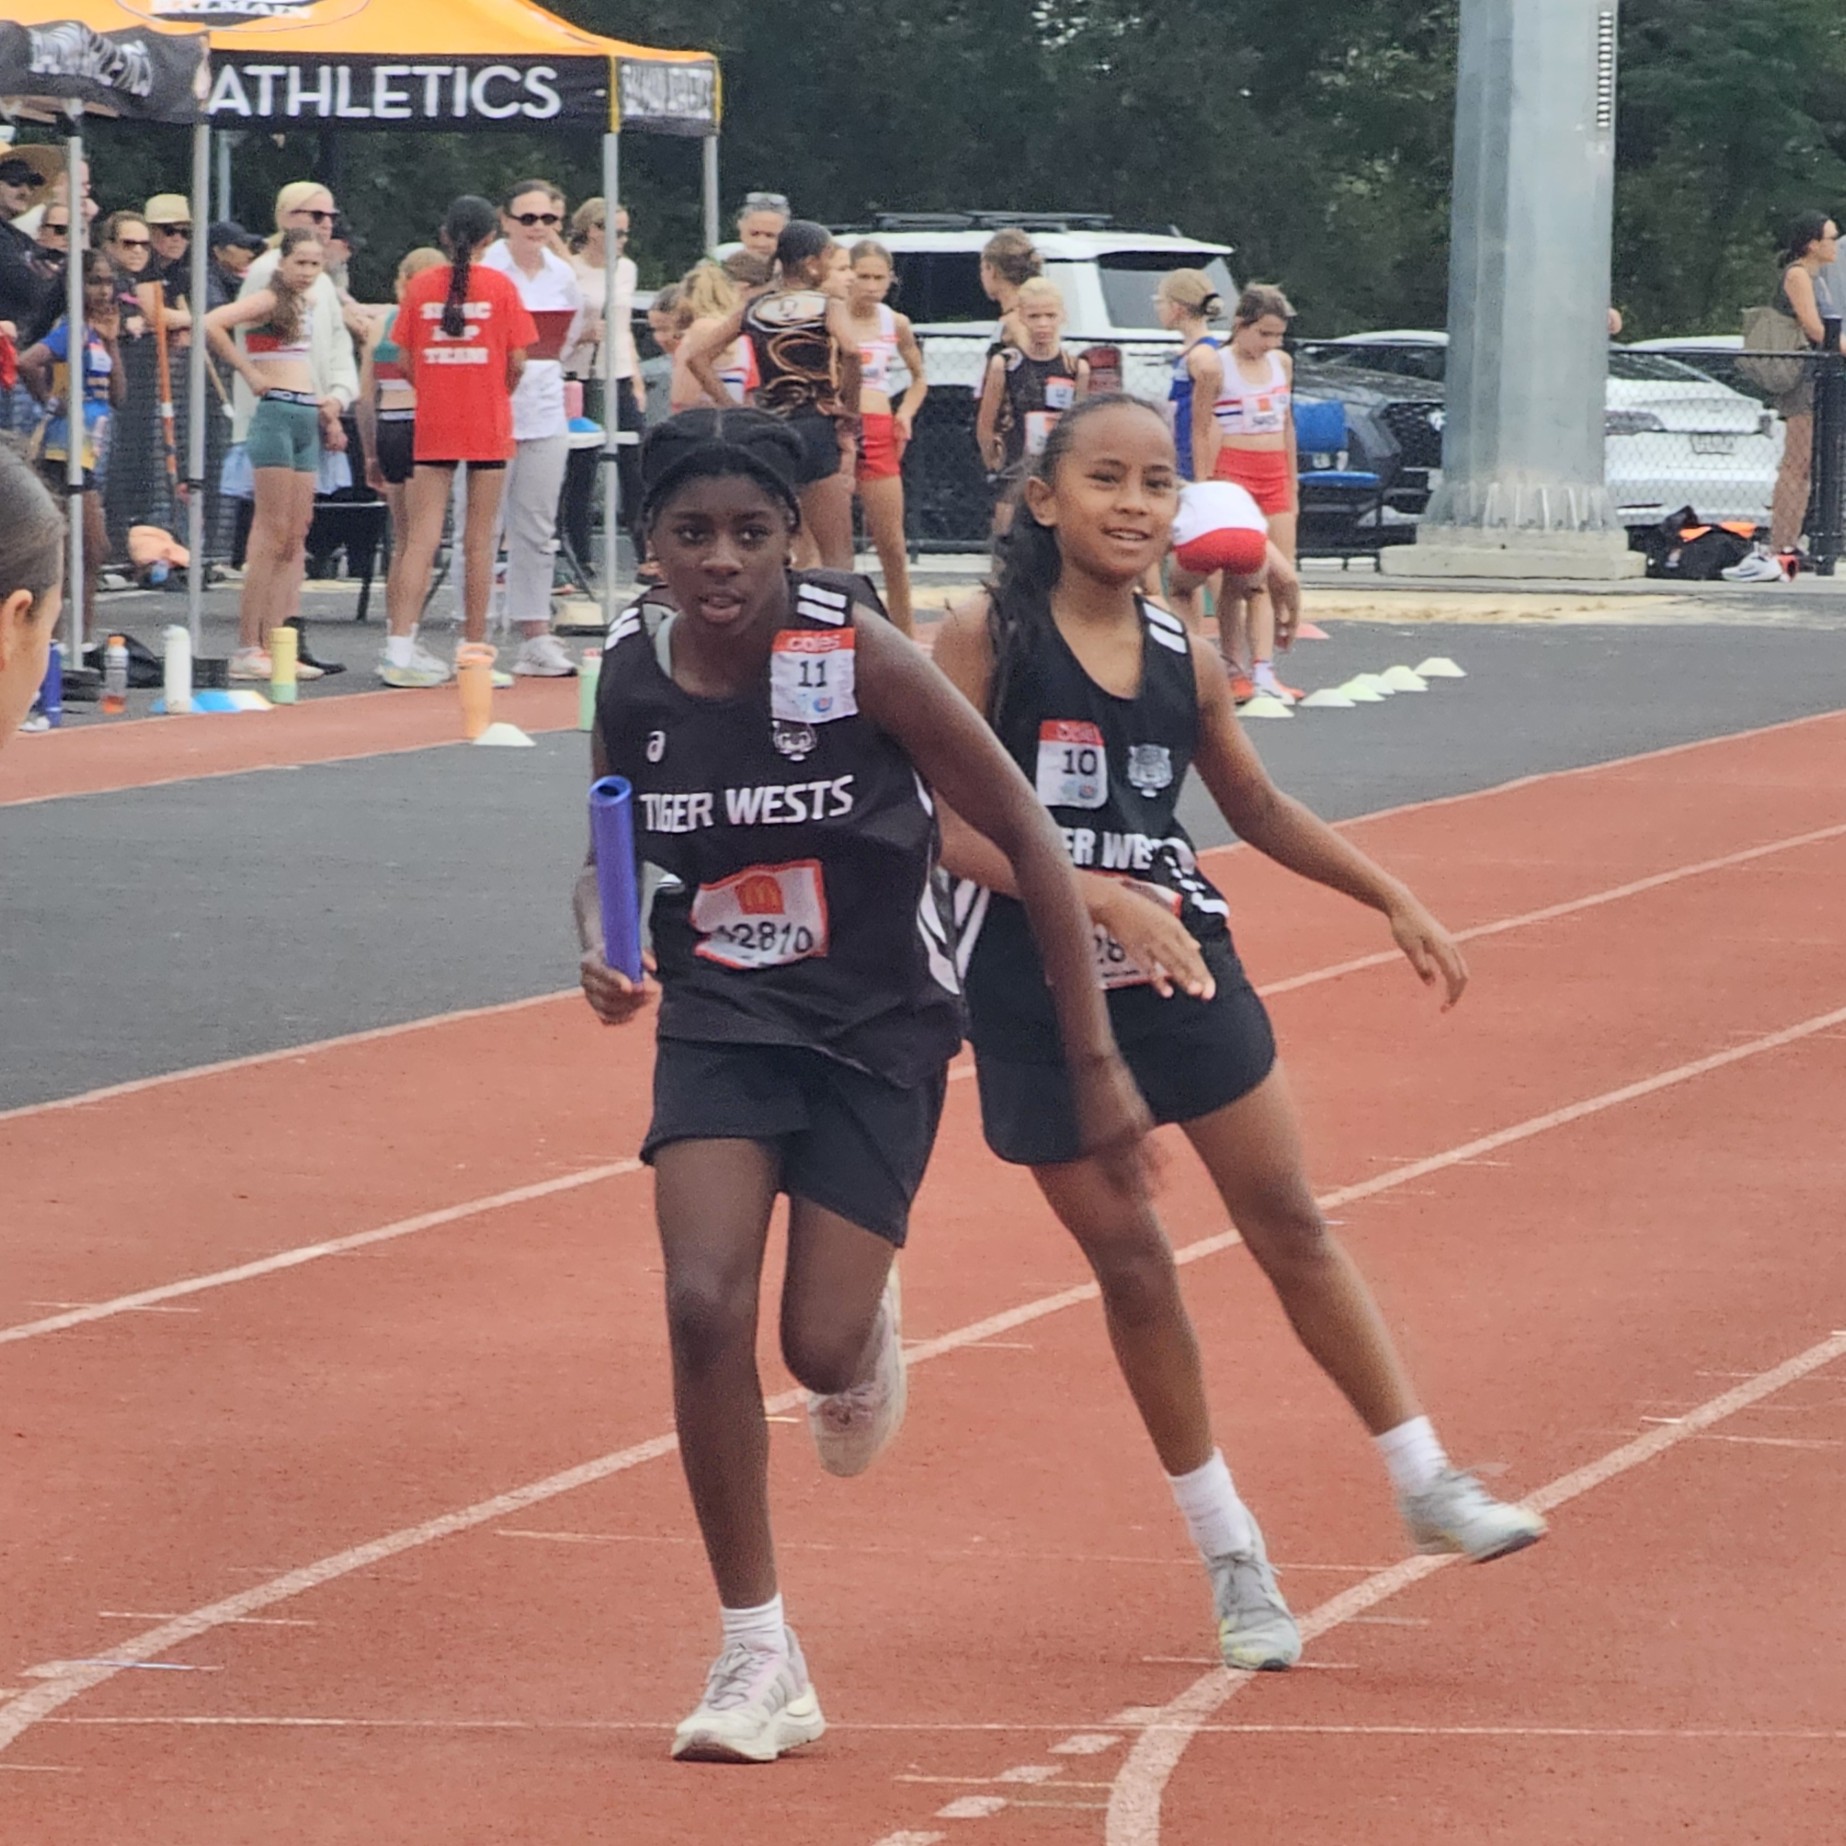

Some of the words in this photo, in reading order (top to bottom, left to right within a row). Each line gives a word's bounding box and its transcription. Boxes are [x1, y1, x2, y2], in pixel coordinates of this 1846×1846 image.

[207, 64, 562, 119] ATHLETICS
[798, 660, 827, 688] 11
[1062, 748, 1098, 776] 10
[639, 792, 715, 833] TIGER
[725, 774, 854, 826] WESTS
